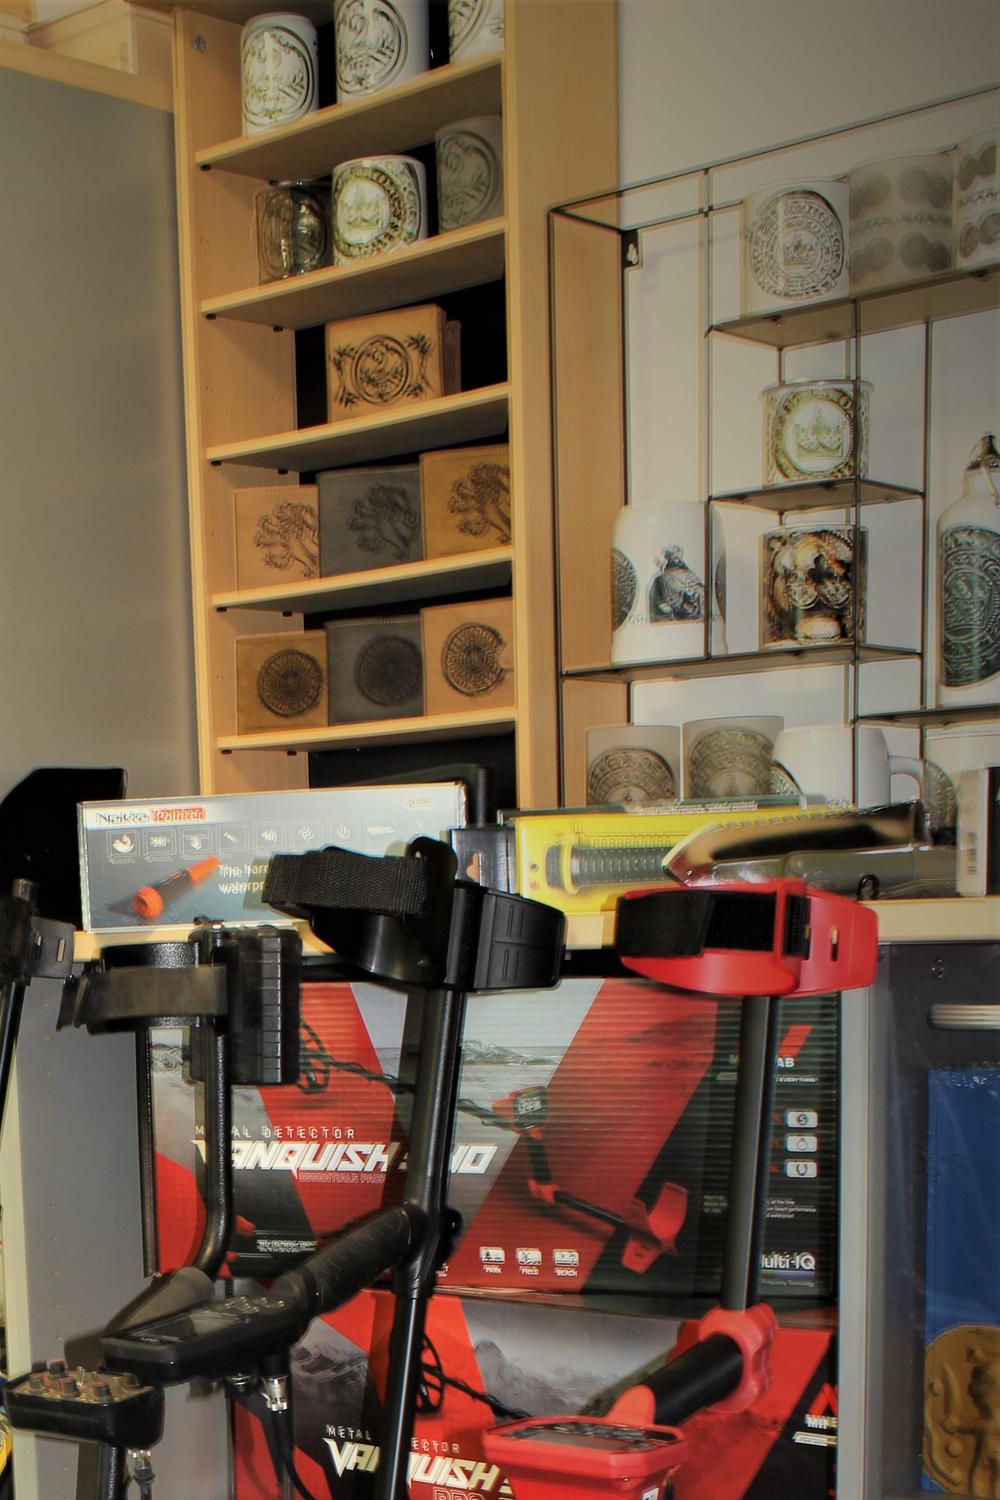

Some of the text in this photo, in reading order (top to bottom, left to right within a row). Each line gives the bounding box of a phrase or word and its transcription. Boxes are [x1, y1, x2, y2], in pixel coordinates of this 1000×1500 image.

[96, 810, 149, 825] Nokta
[218, 864, 242, 878] The
[195, 1126, 356, 1140] MAL DETECTOR
[805, 1413, 839, 1430] MINE
[325, 1424, 461, 1454] METAL ECTOR
